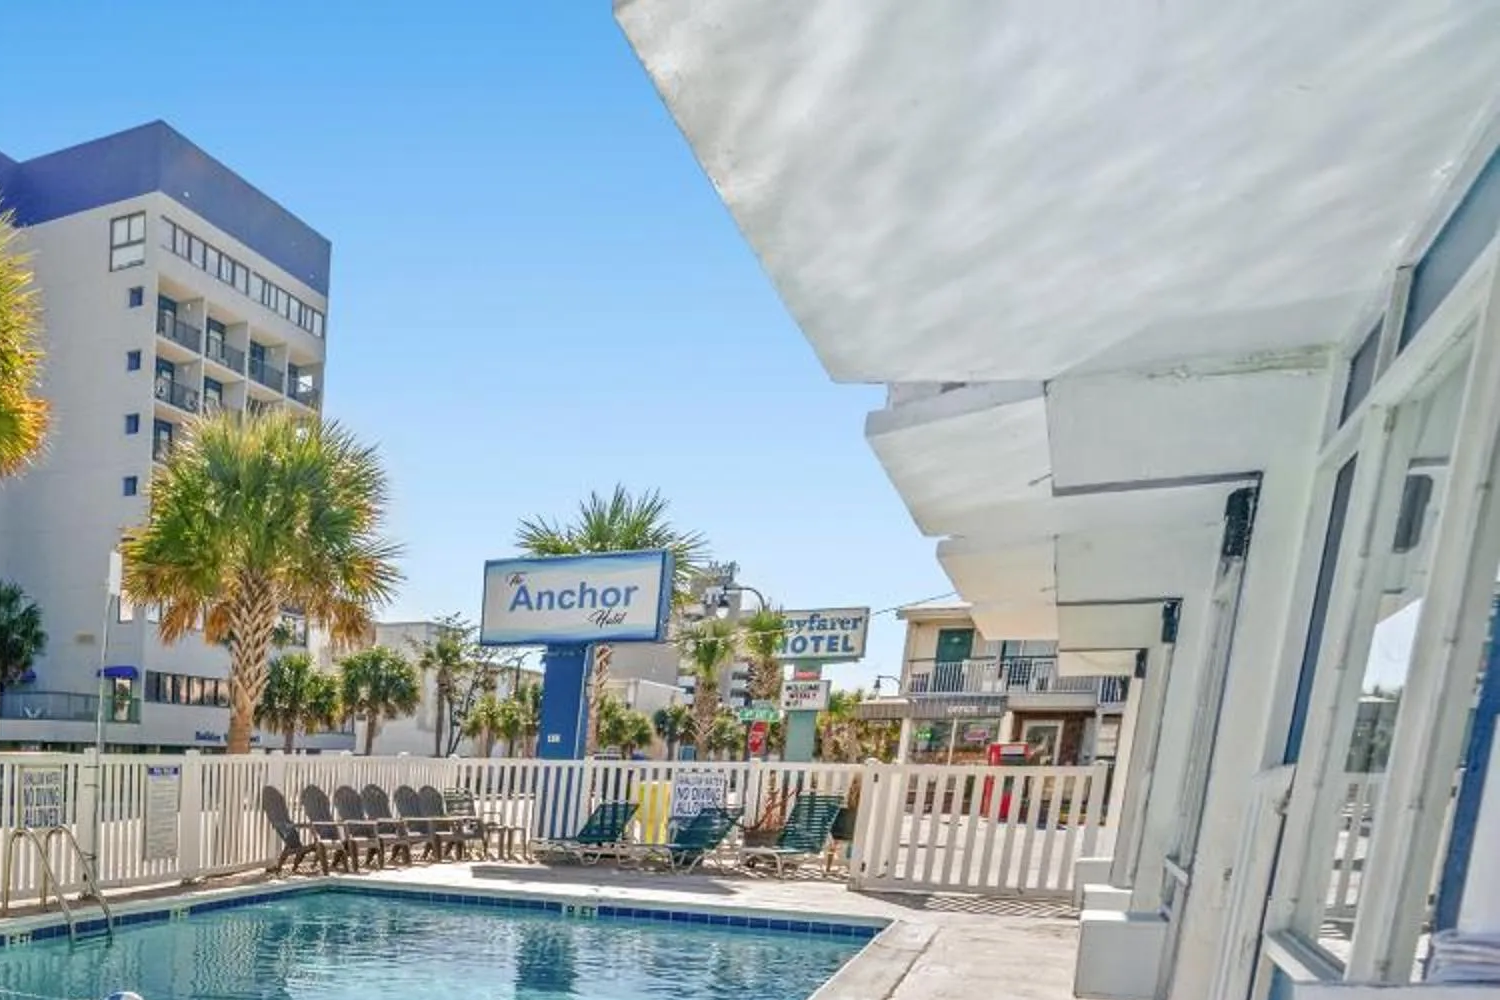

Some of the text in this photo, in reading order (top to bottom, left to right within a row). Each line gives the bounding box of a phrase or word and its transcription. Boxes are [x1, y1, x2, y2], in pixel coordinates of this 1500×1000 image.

[509, 581, 638, 611] Anchor
[24, 787, 60, 807] NO DIVING
[677, 787, 721, 801] NO DIVING
